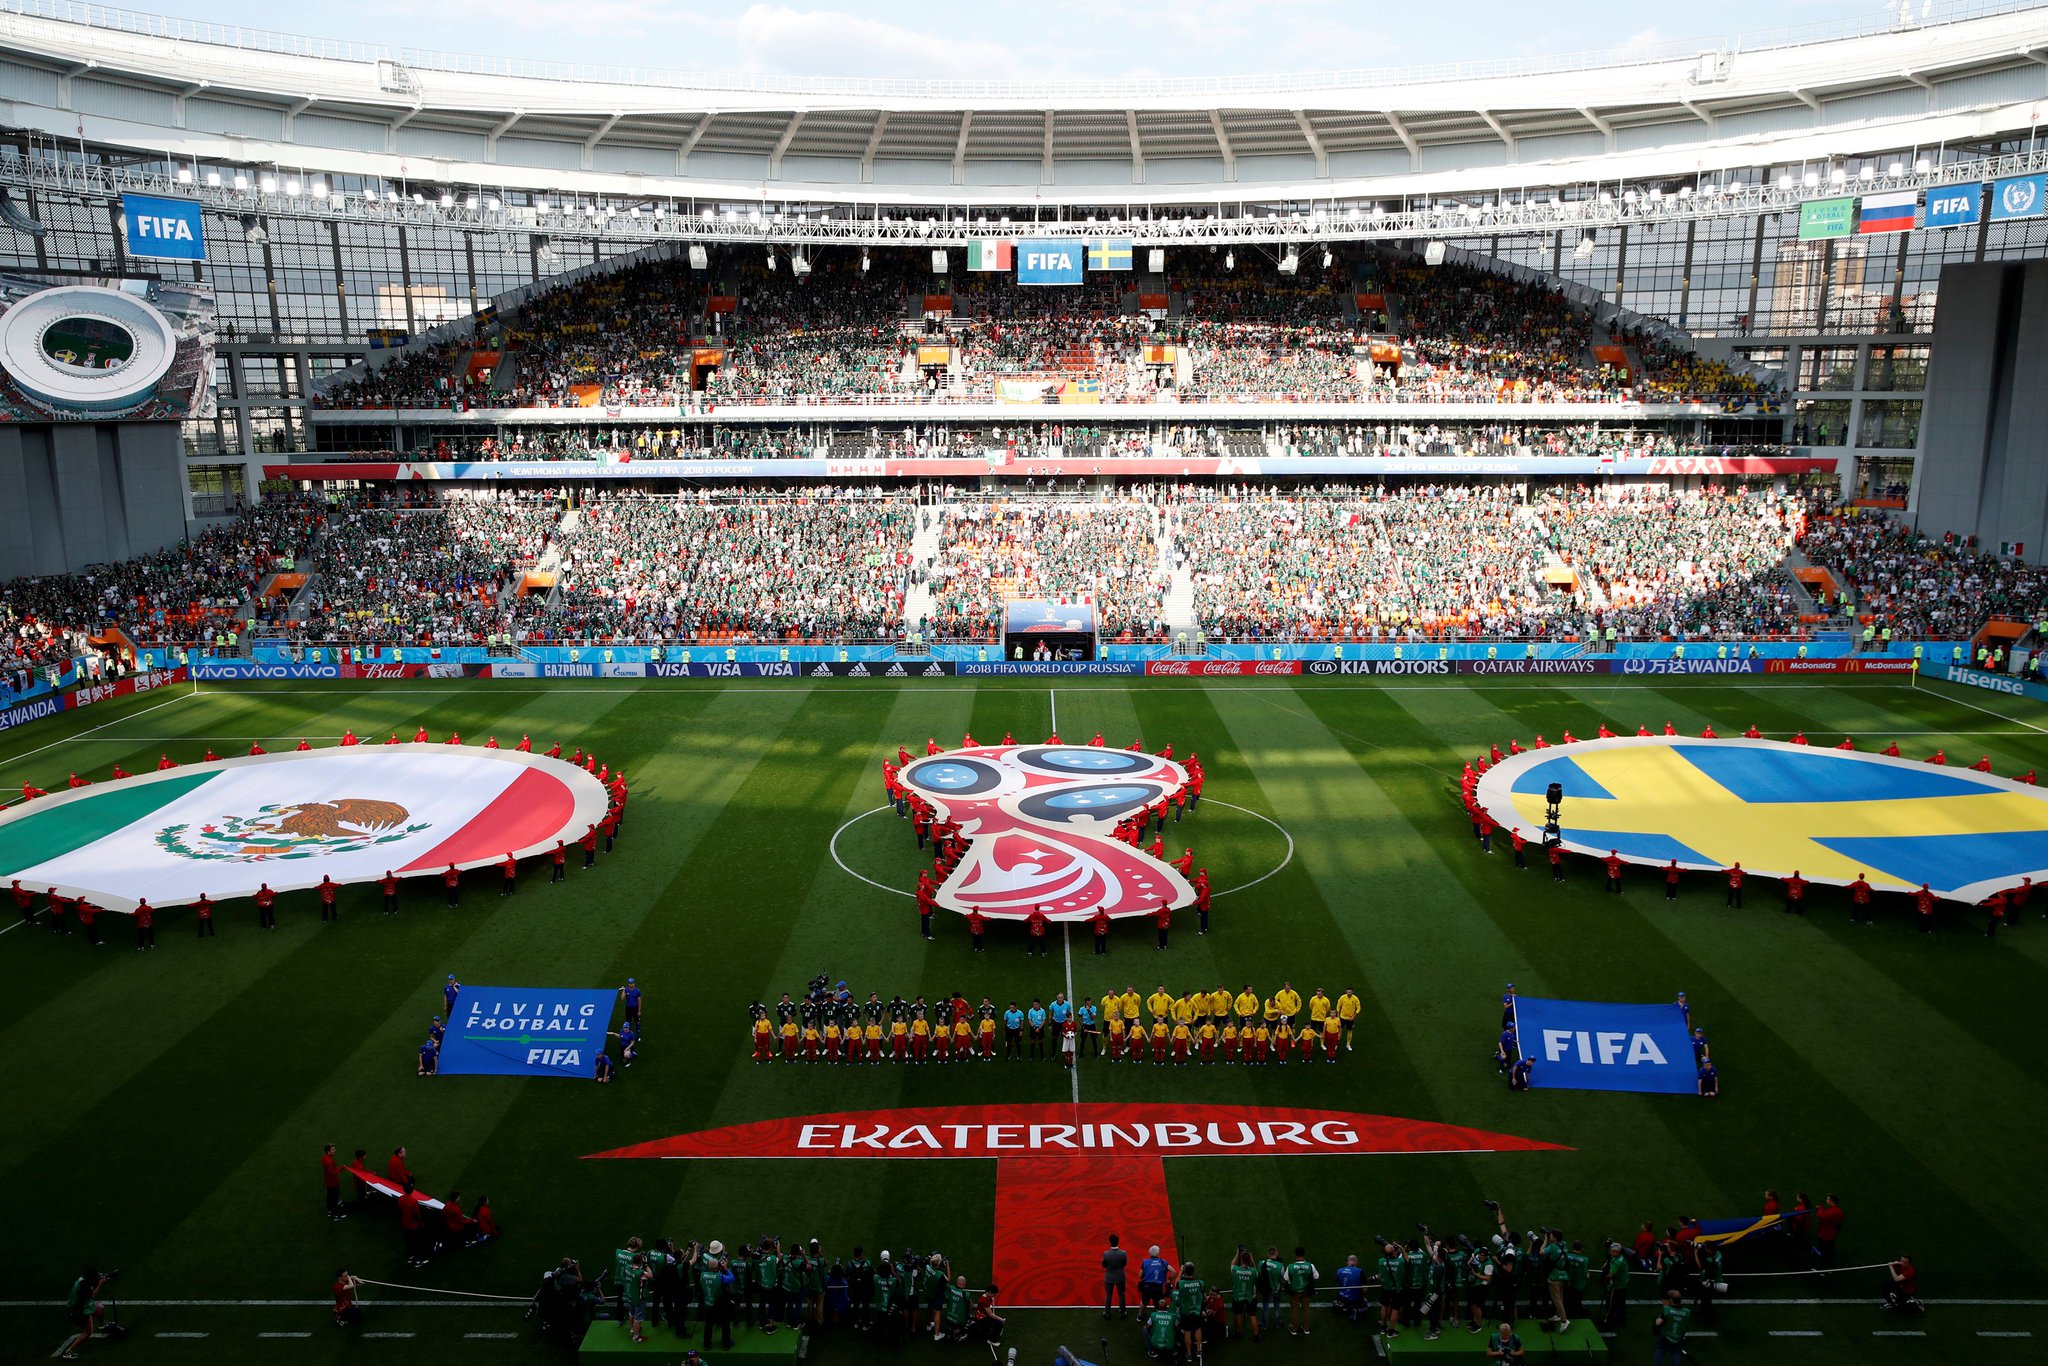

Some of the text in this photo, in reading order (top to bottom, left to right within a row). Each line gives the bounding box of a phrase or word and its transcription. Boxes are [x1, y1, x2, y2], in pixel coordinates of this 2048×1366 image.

[1807, 205, 1846, 214] LIVING
[1931, 196, 1970, 215] FIFA
[137, 215, 194, 241] FIFA
[1827, 223, 1844, 232] FIFA
[1027, 253, 1073, 270] FIFA
[510, 466, 568, 476] ЧЕМПИОНАТ
[569, 466, 598, 475] МИРА
[599, 466, 612, 475] ПО
[614, 466, 658, 475] ФУТБОЛУ
[660, 466, 679, 474] FIFA
[683, 466, 705, 474] 2018
[241, 665, 287, 677] vivo
[291, 665, 337, 677] vivo
[362, 663, 406, 679] Bud
[545, 664, 593, 677] GAZPROM
[653, 663, 691, 676] VISA
[704, 663, 742, 676] VISA
[756, 663, 794, 676] VISA
[965, 664, 992, 674] 2018
[994, 664, 1018, 673] FIFA
[1019, 664, 1061, 673] WORLD
[1063, 664, 1089, 673] CUP
[1312, 664, 1334, 672] KIA
[1340, 661, 1449, 674] KIA MOTORS
[1473, 661, 1595, 674] QATAR AIRWAYS
[1648, 659, 1753, 674] 万达 WANDA
[1789, 662, 1837, 670] McDonald's
[810, 670, 833, 678] adidas
[847, 670, 870, 678] adidas
[884, 670, 907, 678] adidas
[921, 670, 944, 678] adidas
[1947, 665, 2024, 696] Hisense
[91, 684, 116, 702] 蒙牛
[8, 698, 58, 727] WANDA
[470, 1001, 596, 1016] LIVING
[1543, 1029, 1669, 1065] FIFA
[527, 1048, 582, 1067] FIFA
[797, 1121, 1360, 1149] EKATERINBURG
